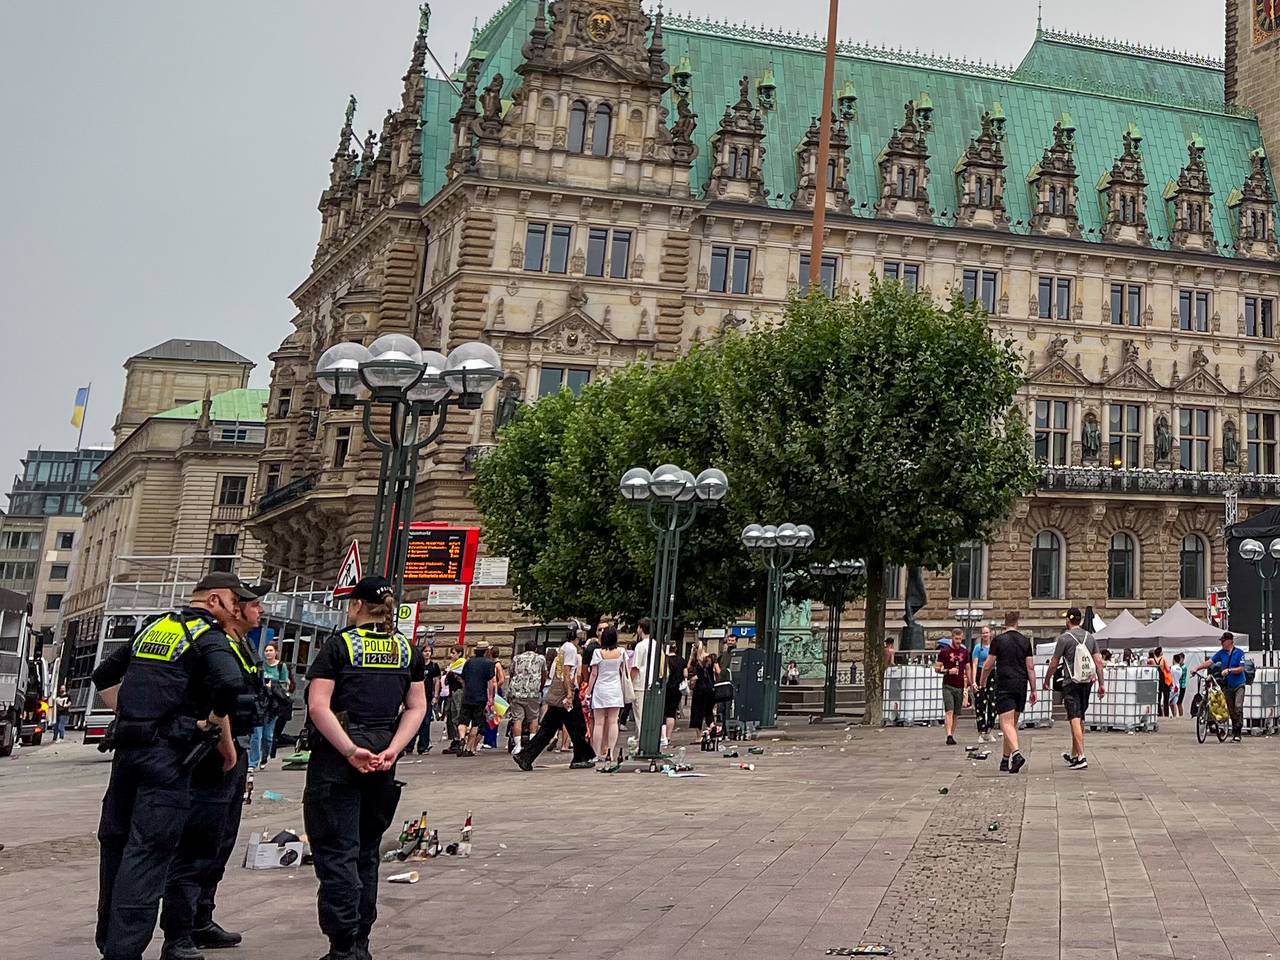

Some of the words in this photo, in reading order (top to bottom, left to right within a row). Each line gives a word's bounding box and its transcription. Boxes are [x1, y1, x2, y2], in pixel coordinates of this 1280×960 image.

[146, 631, 179, 644] POLIZEI
[364, 640, 393, 652] POLIZ
[366, 653, 398, 664] 121392
